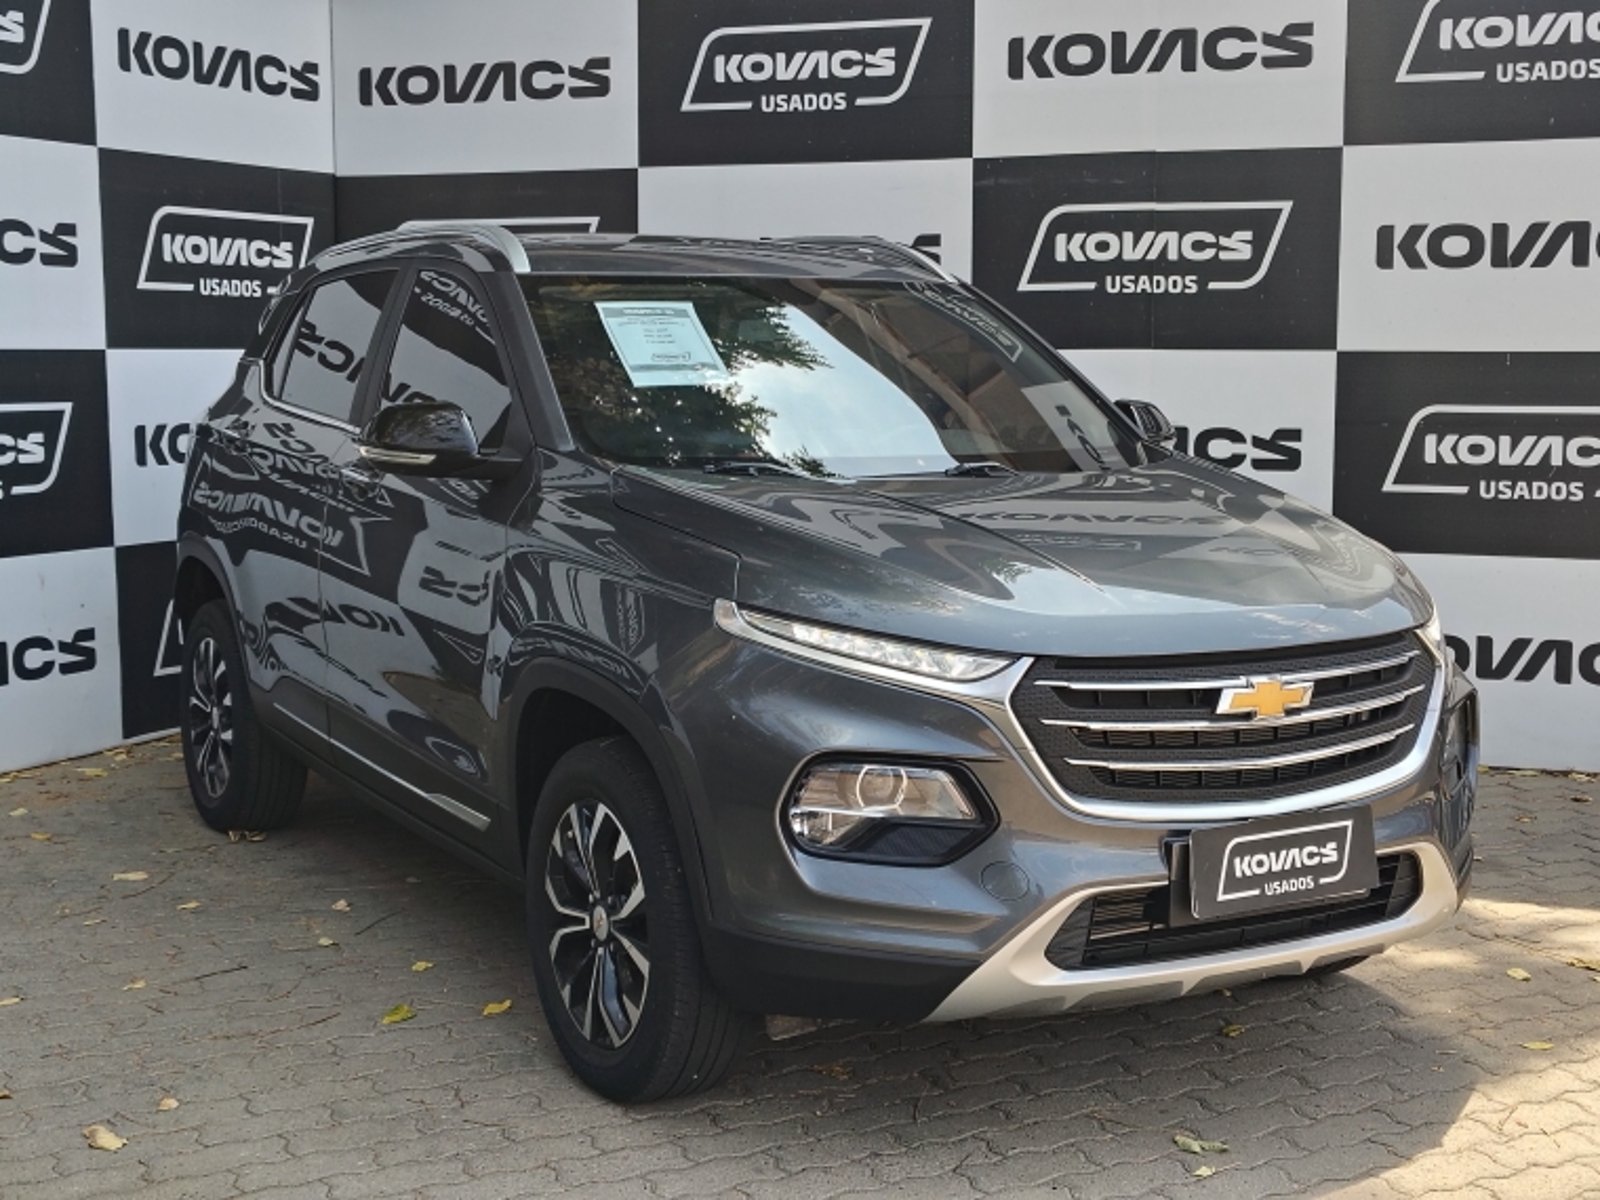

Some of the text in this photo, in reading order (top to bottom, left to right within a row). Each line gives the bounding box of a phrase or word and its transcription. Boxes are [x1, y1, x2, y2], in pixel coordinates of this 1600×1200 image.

[118, 27, 319, 102] KOVACS
[714, 47, 896, 83] KOVACS
[1008, 22, 1314, 80] KOVACS
[358, 56, 611, 106] KOVACS
[761, 92, 847, 113] USADOS
[162, 233, 293, 269] KOVACS
[1055, 230, 1253, 262] KOVACS
[1376, 221, 1600, 270] KOVA
[199, 277, 262, 298] USADOS
[1105, 275, 1198, 294] USADOS
[1479, 480, 1584, 501] USADOS
[1233, 841, 1339, 878] KOVACS
[1264, 875, 1316, 896] USADOS
